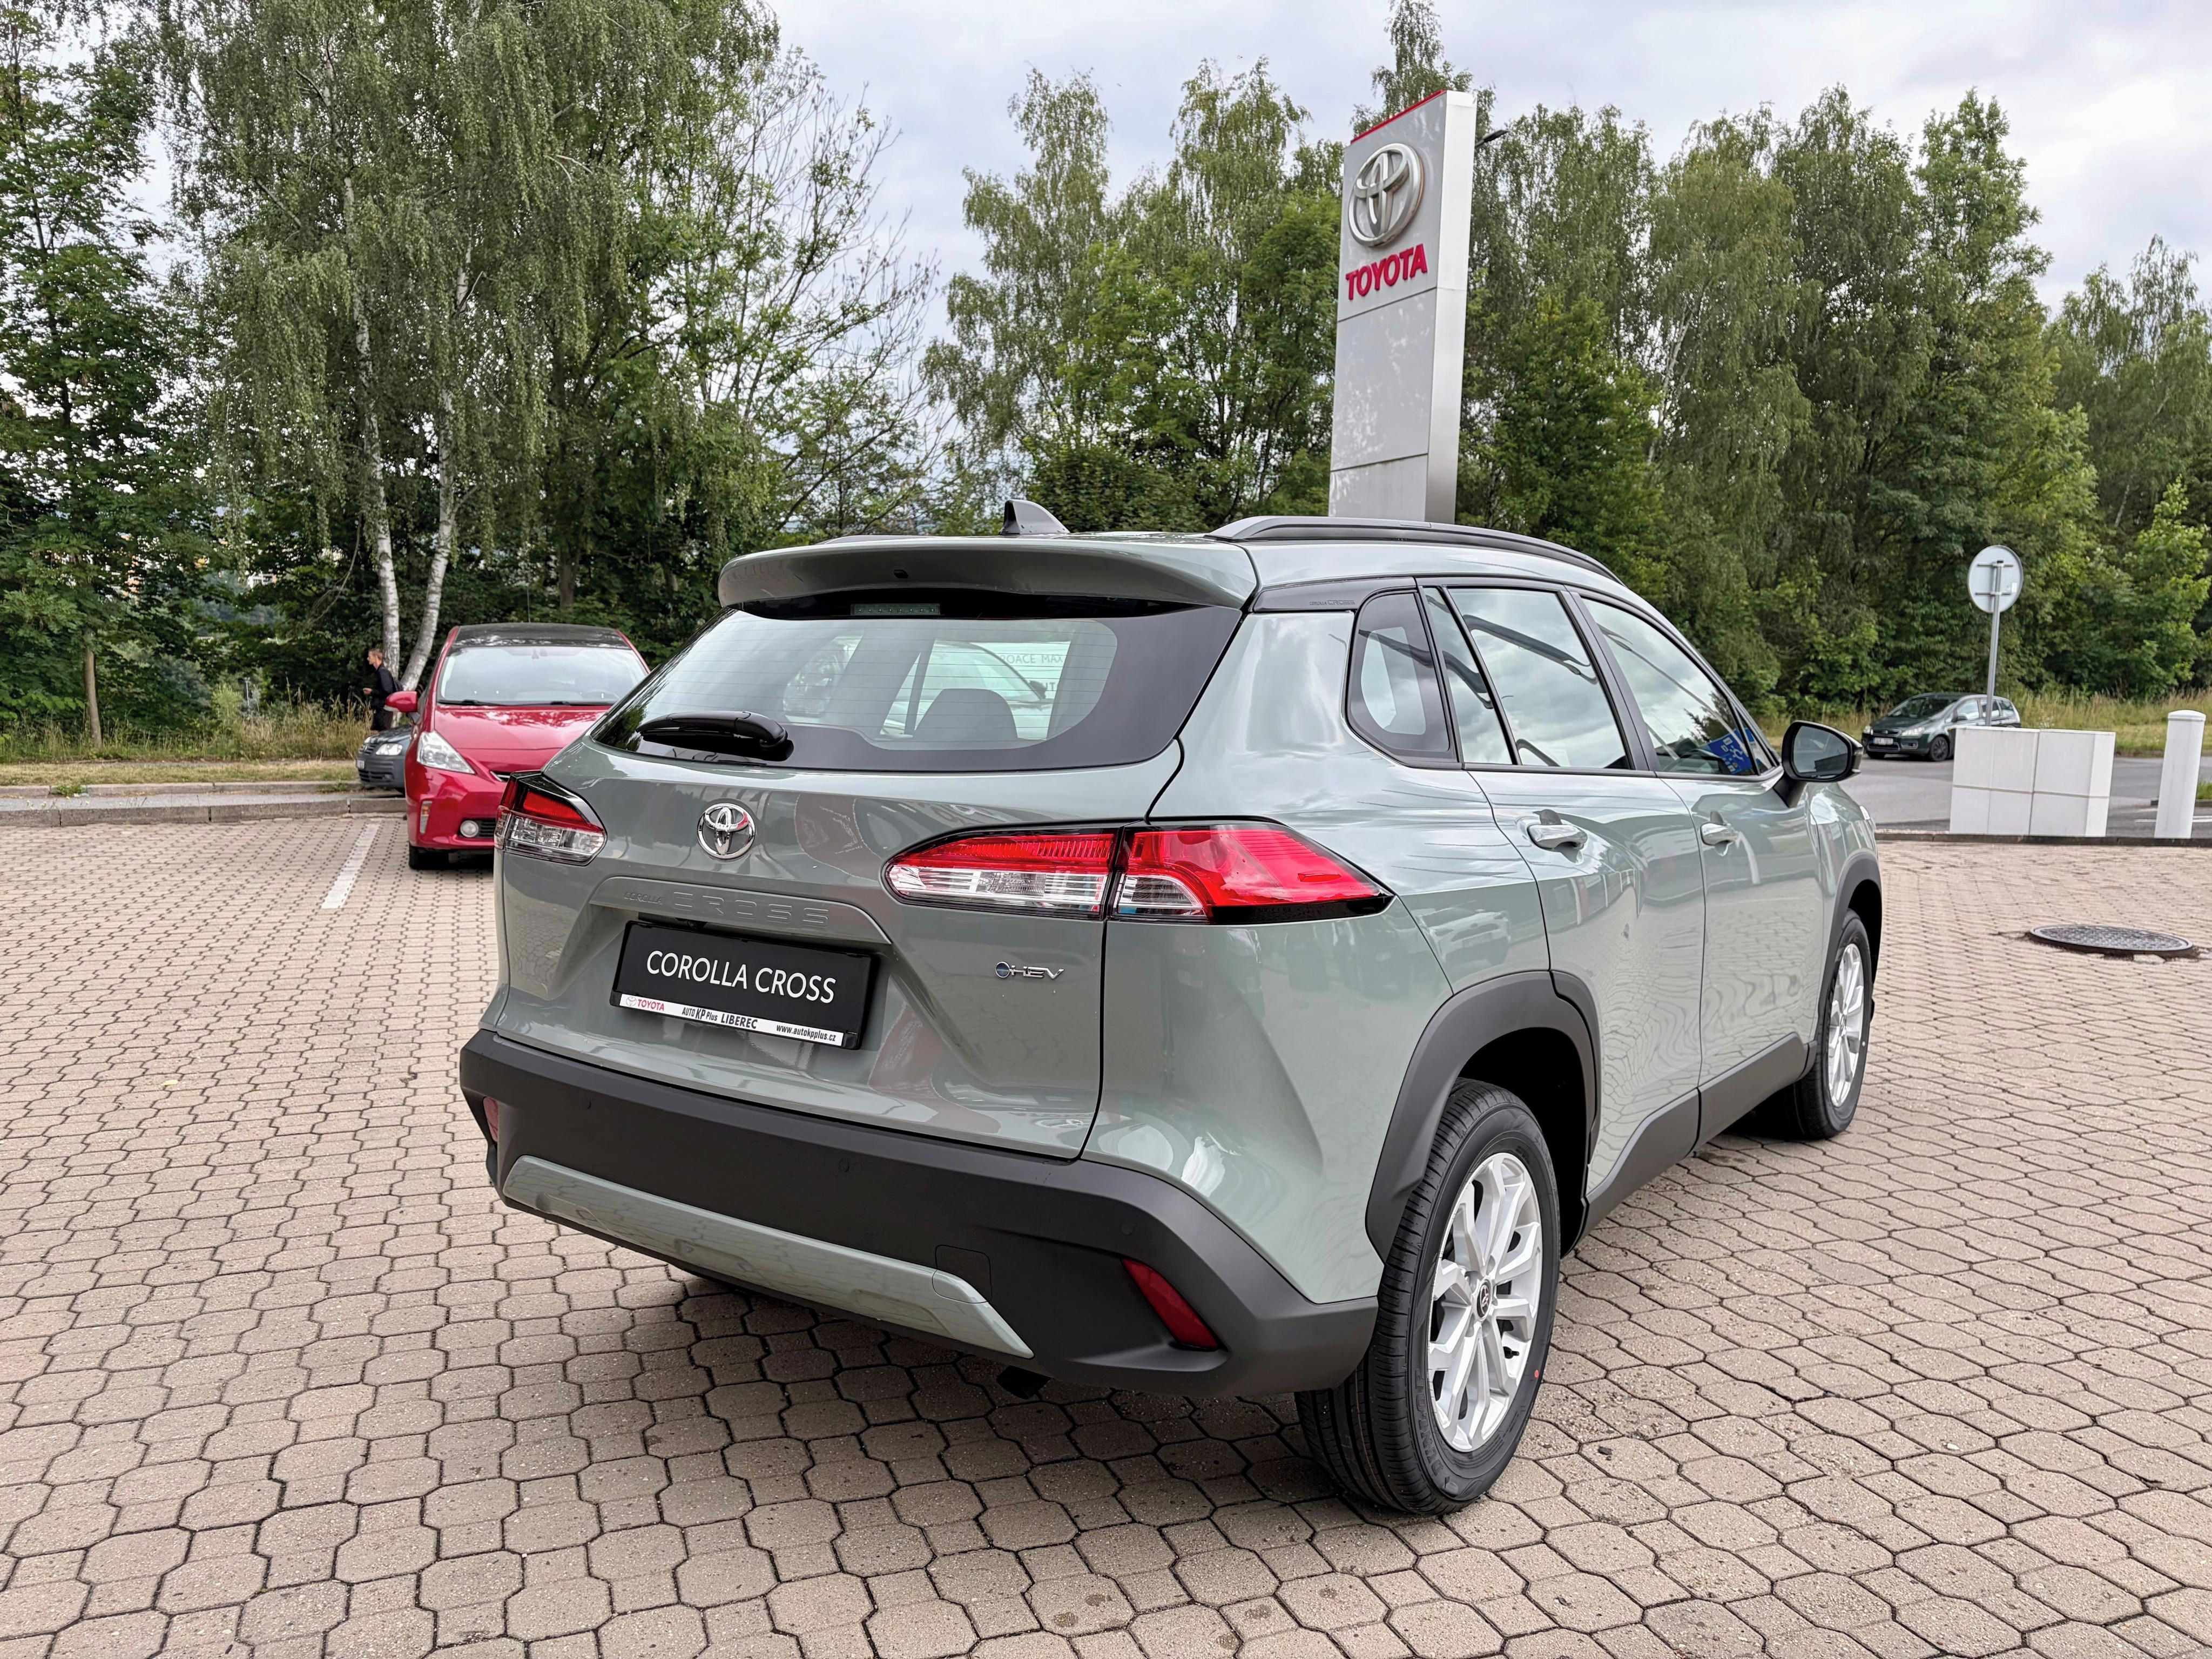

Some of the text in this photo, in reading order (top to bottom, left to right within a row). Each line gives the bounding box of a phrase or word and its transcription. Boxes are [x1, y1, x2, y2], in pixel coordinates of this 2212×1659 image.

[1345, 244, 1427, 300] TOYOTA
[1041, 655, 1063, 664] MAX
[623, 891, 830, 928] COROLLA CROSS
[646, 950, 837, 1004] COROLLA CROSS
[637, 999, 665, 1011] TOYOTA
[682, 1007, 758, 1029] AUTO KP Plus LIBEREC
[776, 1024, 837, 1042] www.autokpplus.cz
[1415, 1368, 1444, 1476] DUNLOP
